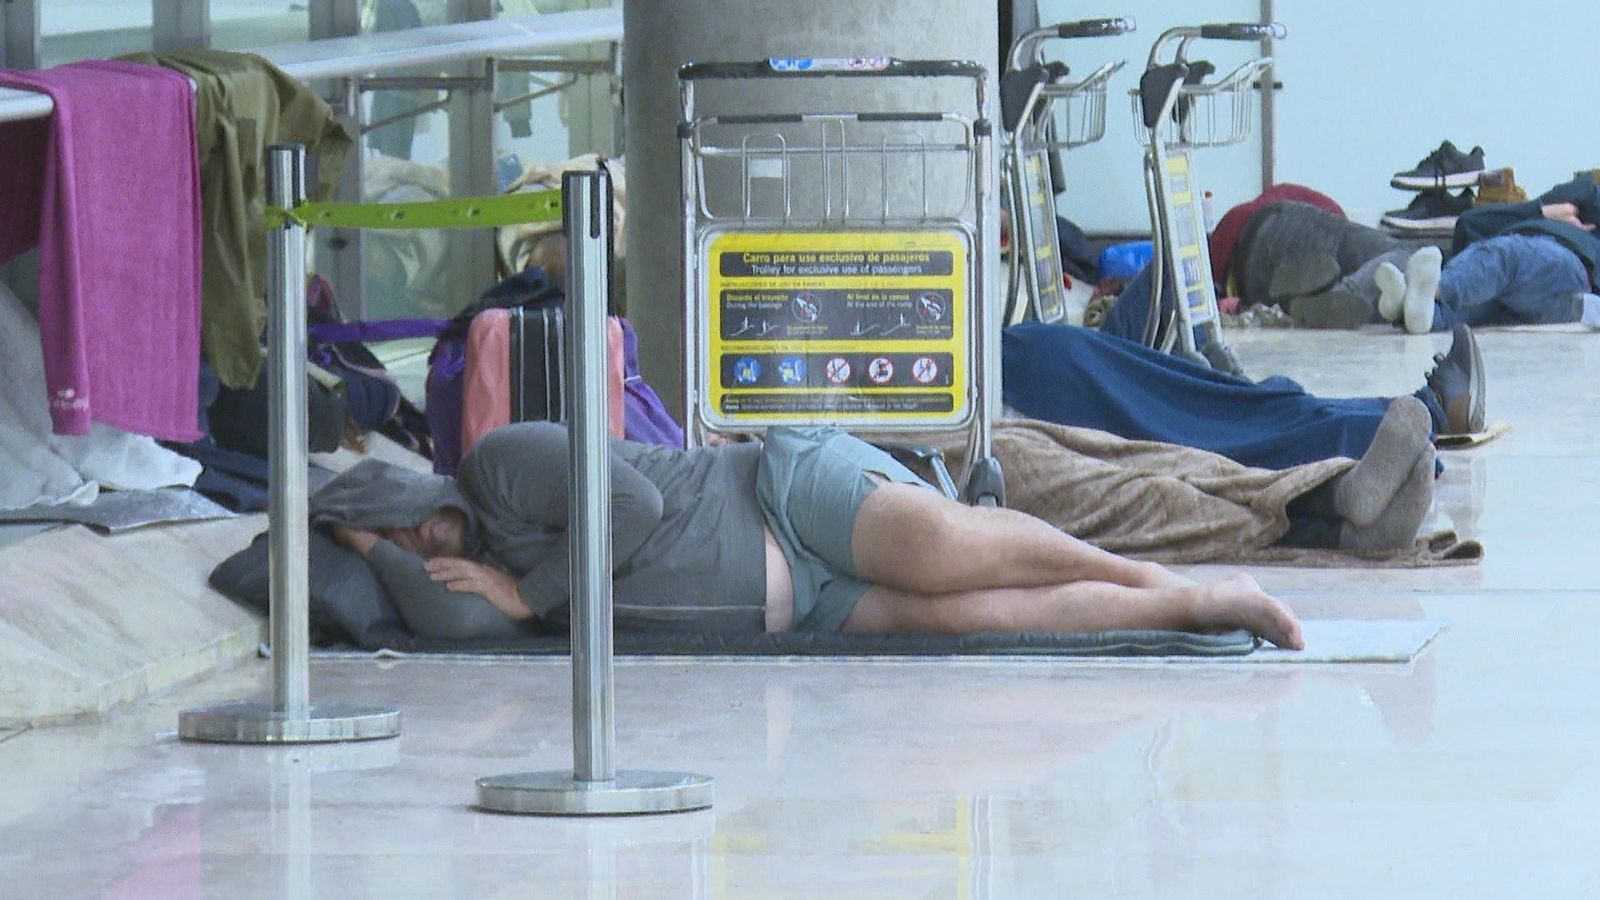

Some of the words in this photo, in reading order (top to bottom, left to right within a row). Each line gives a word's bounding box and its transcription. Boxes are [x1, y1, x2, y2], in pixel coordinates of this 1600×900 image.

[743, 253, 770, 263] Carro
[773, 253, 796, 265] para
[799, 254, 816, 263] uso
[819, 253, 865, 263] exclusivo
[867, 253, 880, 263] de
[882, 253, 930, 265] pasajeros
[752, 264, 781, 276] Trolley
[783, 264, 796, 275] for
[798, 264, 839, 275] exclusive
[841, 266, 858, 275] use
[860, 264, 870, 275] of
[872, 265, 922, 276] passengers
